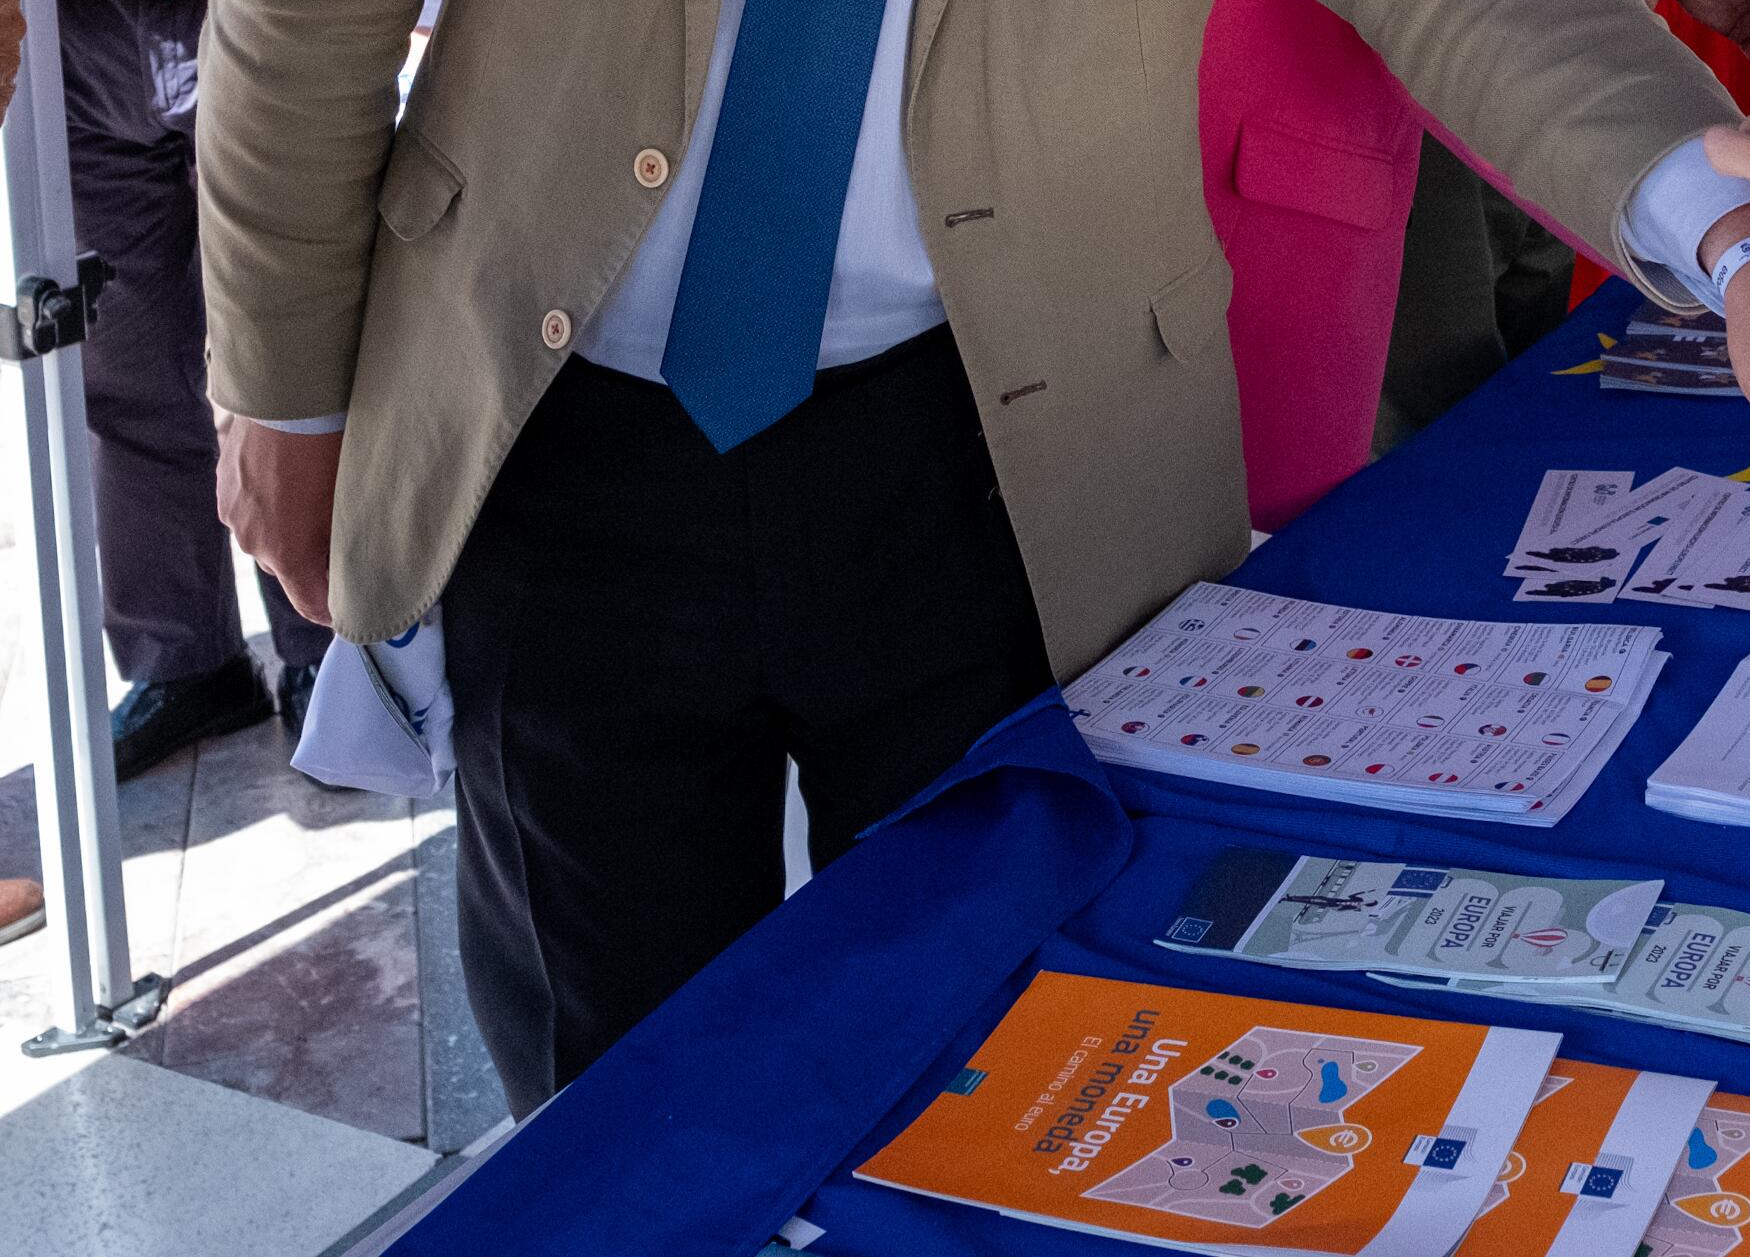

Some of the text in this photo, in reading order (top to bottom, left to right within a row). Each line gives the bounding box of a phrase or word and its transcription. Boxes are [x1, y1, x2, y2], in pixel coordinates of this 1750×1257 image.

[1424, 907, 1446, 926] 2023
[1441, 895, 1492, 951] EUROPA
[1481, 905, 1517, 949] VIAJAR POR
[1645, 944, 1667, 964] 2023
[1661, 931, 1717, 991] EUROPA
[1703, 944, 1742, 991] VIAJAR POR
[1014, 1035, 1103, 1132] El camino al euro
[1032, 1008, 1161, 1154] una moneda
[1048, 1038, 1189, 1176] Una Europa,
